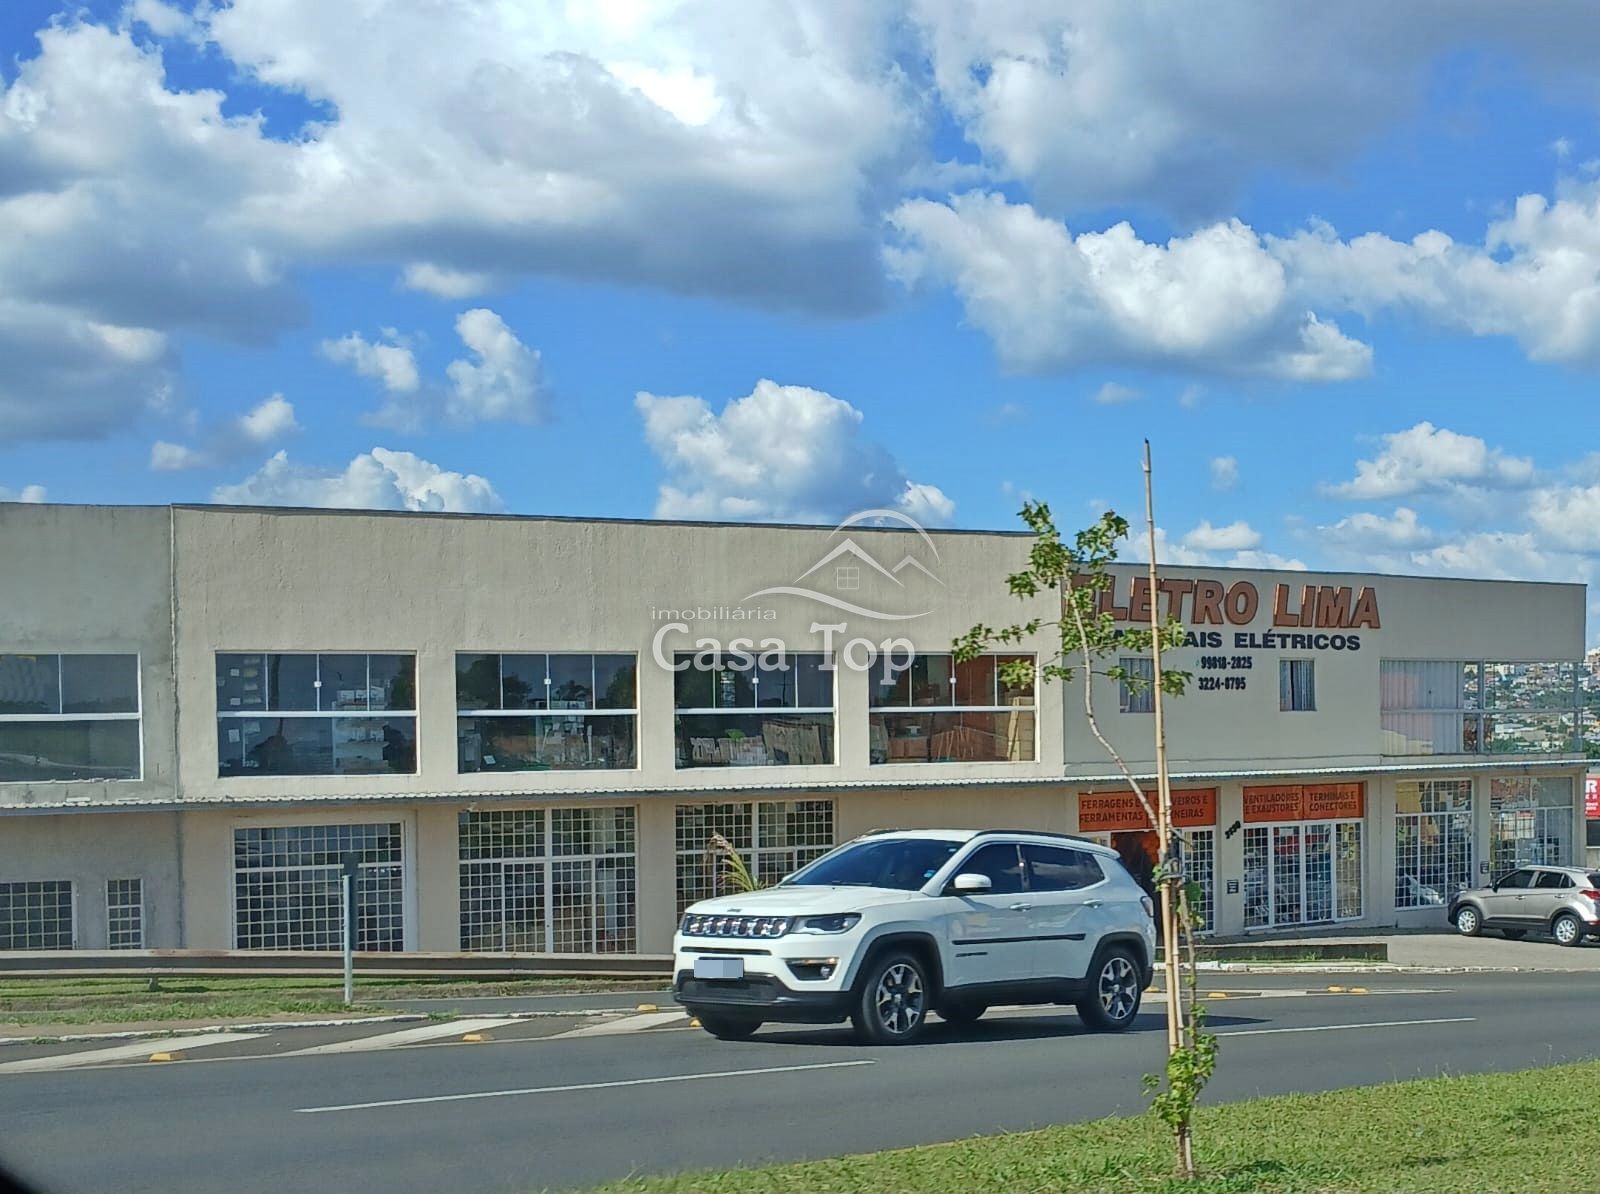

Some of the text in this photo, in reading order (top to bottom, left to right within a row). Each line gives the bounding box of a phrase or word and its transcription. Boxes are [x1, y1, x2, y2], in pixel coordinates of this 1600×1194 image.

[1273, 583, 1380, 629] LIMA
[1234, 628, 1361, 651] ELÉTRICOS
[1202, 795, 1209, 805] E
[1309, 791, 1355, 801] TERMINAIS E
[1081, 799, 1135, 810] FERRAGENS
[1245, 803, 1299, 815] E EXAUSTORES
[1309, 801, 1357, 812] CONECTORES
[1079, 811, 1143, 824] FERRAMENTAS
